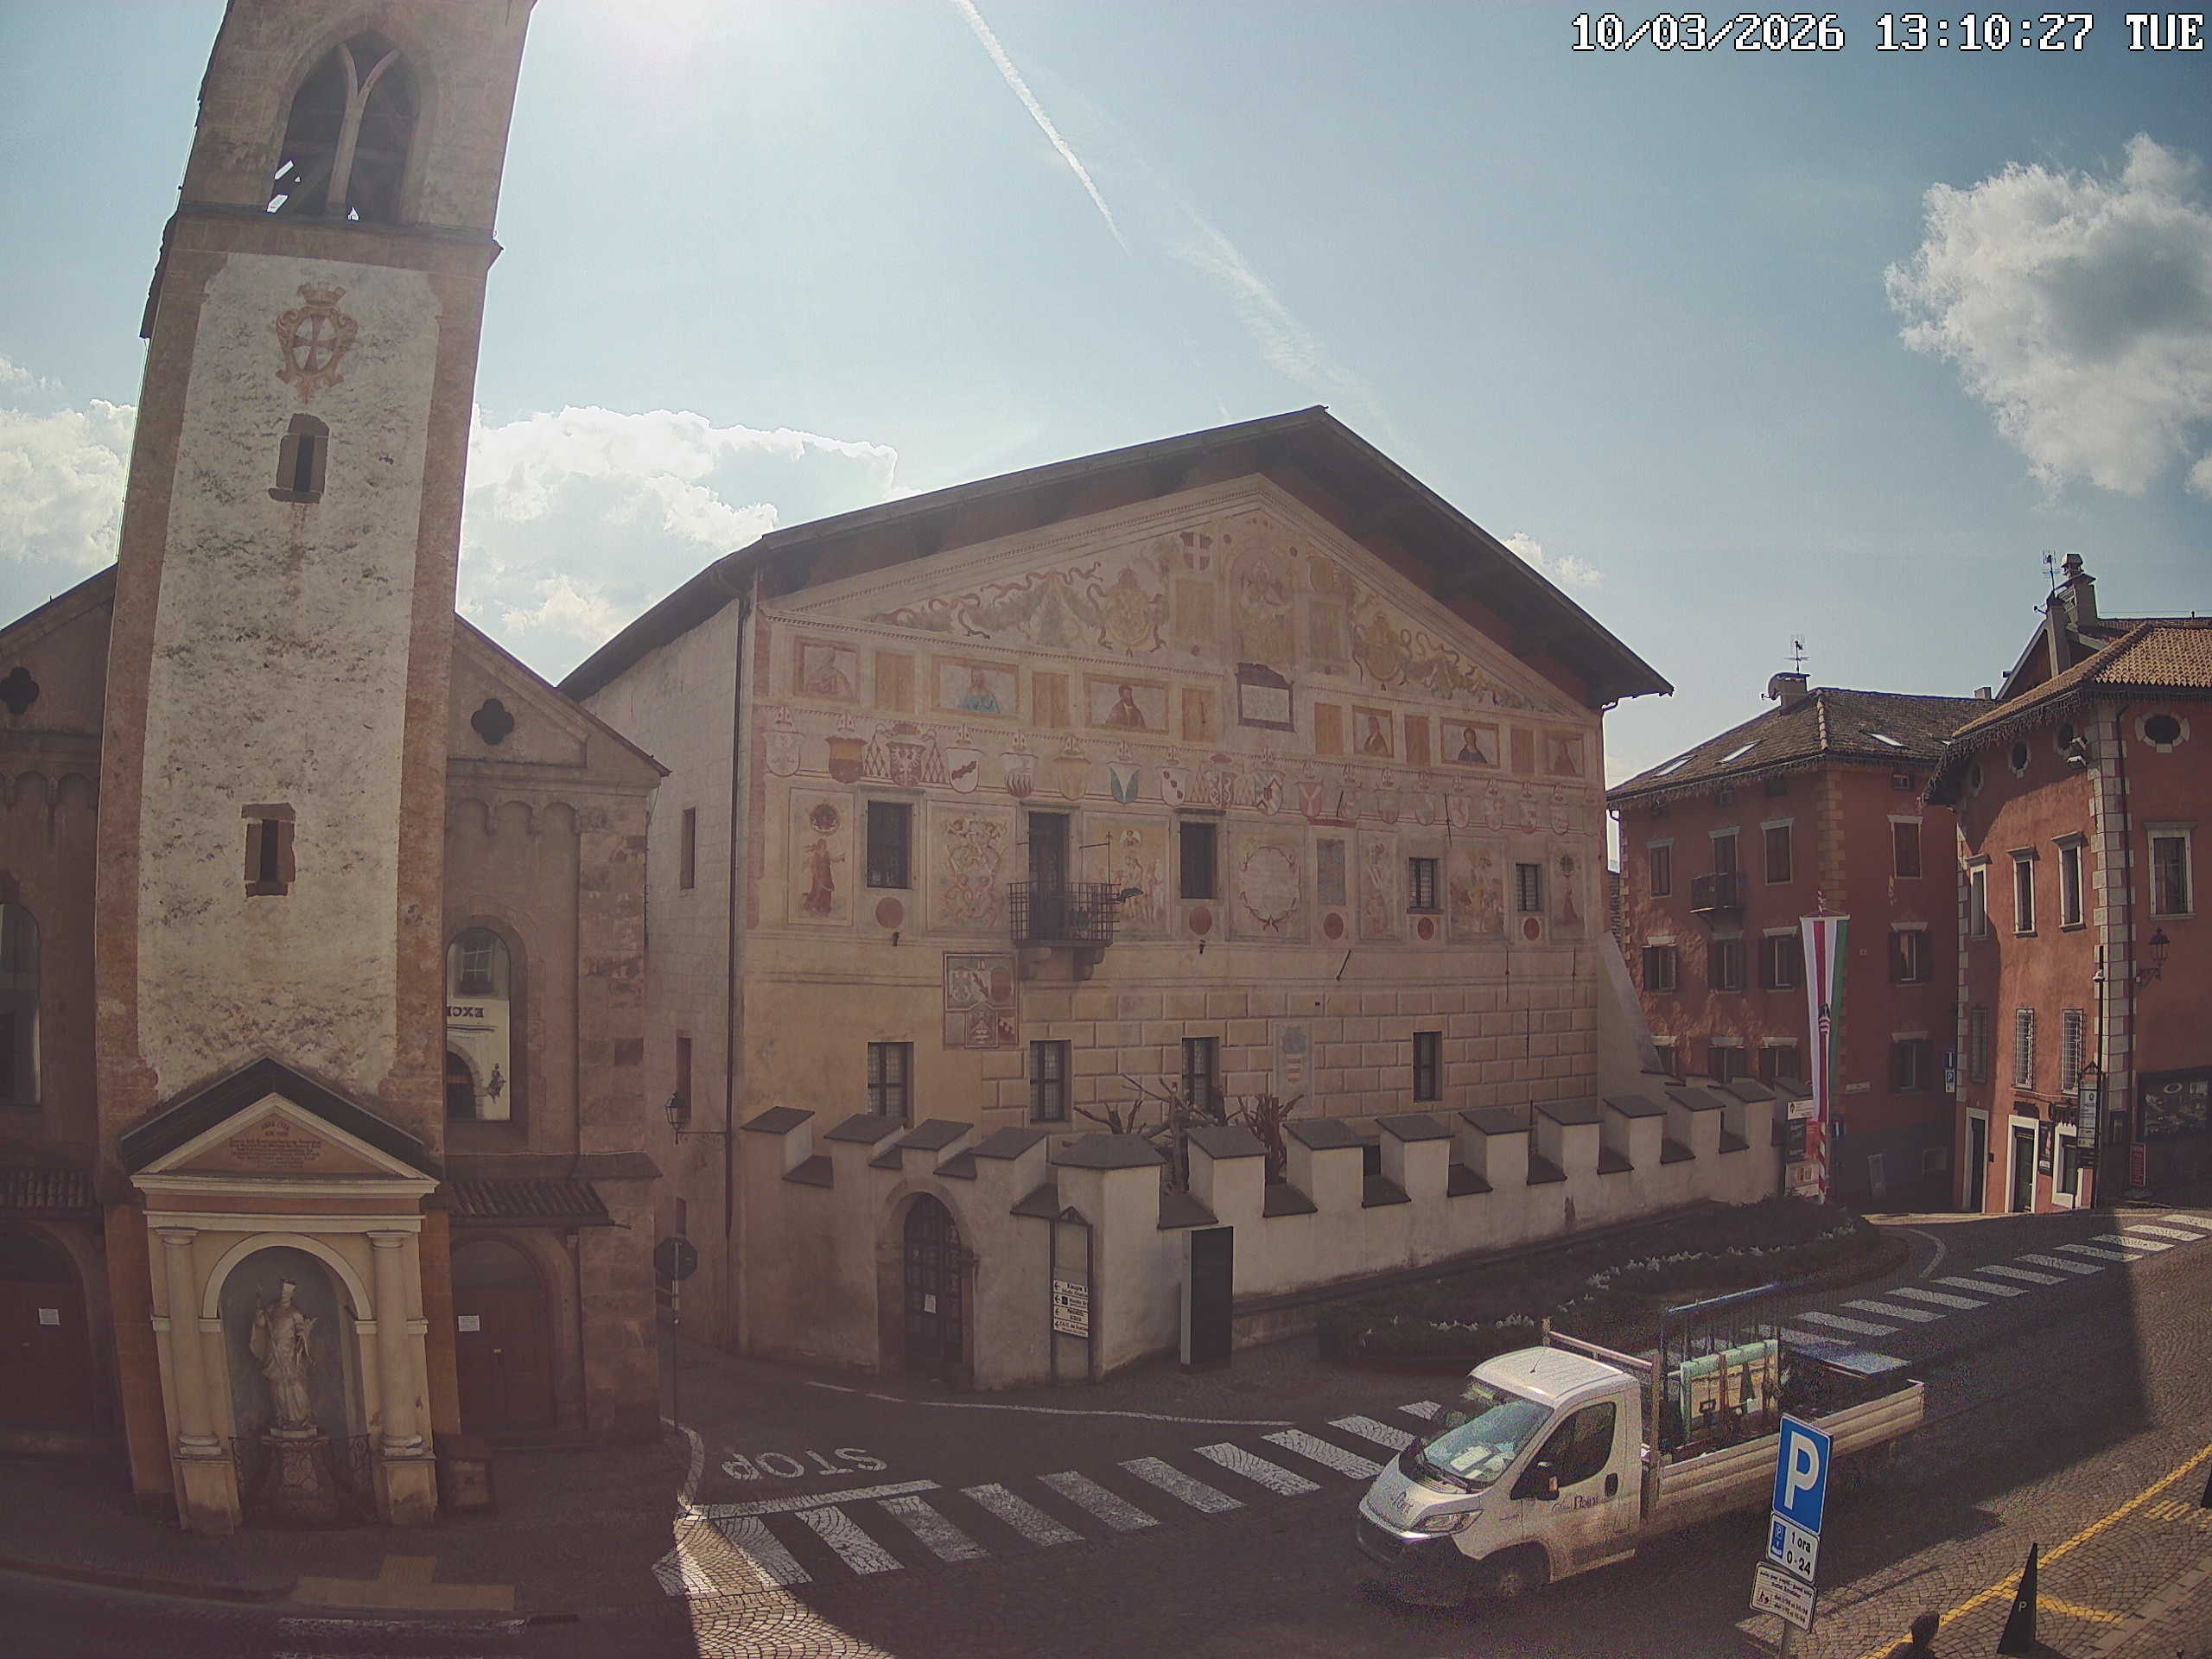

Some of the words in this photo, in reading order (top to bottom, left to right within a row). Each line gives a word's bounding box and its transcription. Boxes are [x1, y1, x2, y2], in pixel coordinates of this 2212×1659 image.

[721, 1447, 887, 1480] STOP
[1783, 1430, 1820, 1510] P
[1791, 1531, 1796, 1545] 1
[1797, 1539, 1811, 1554] ora
